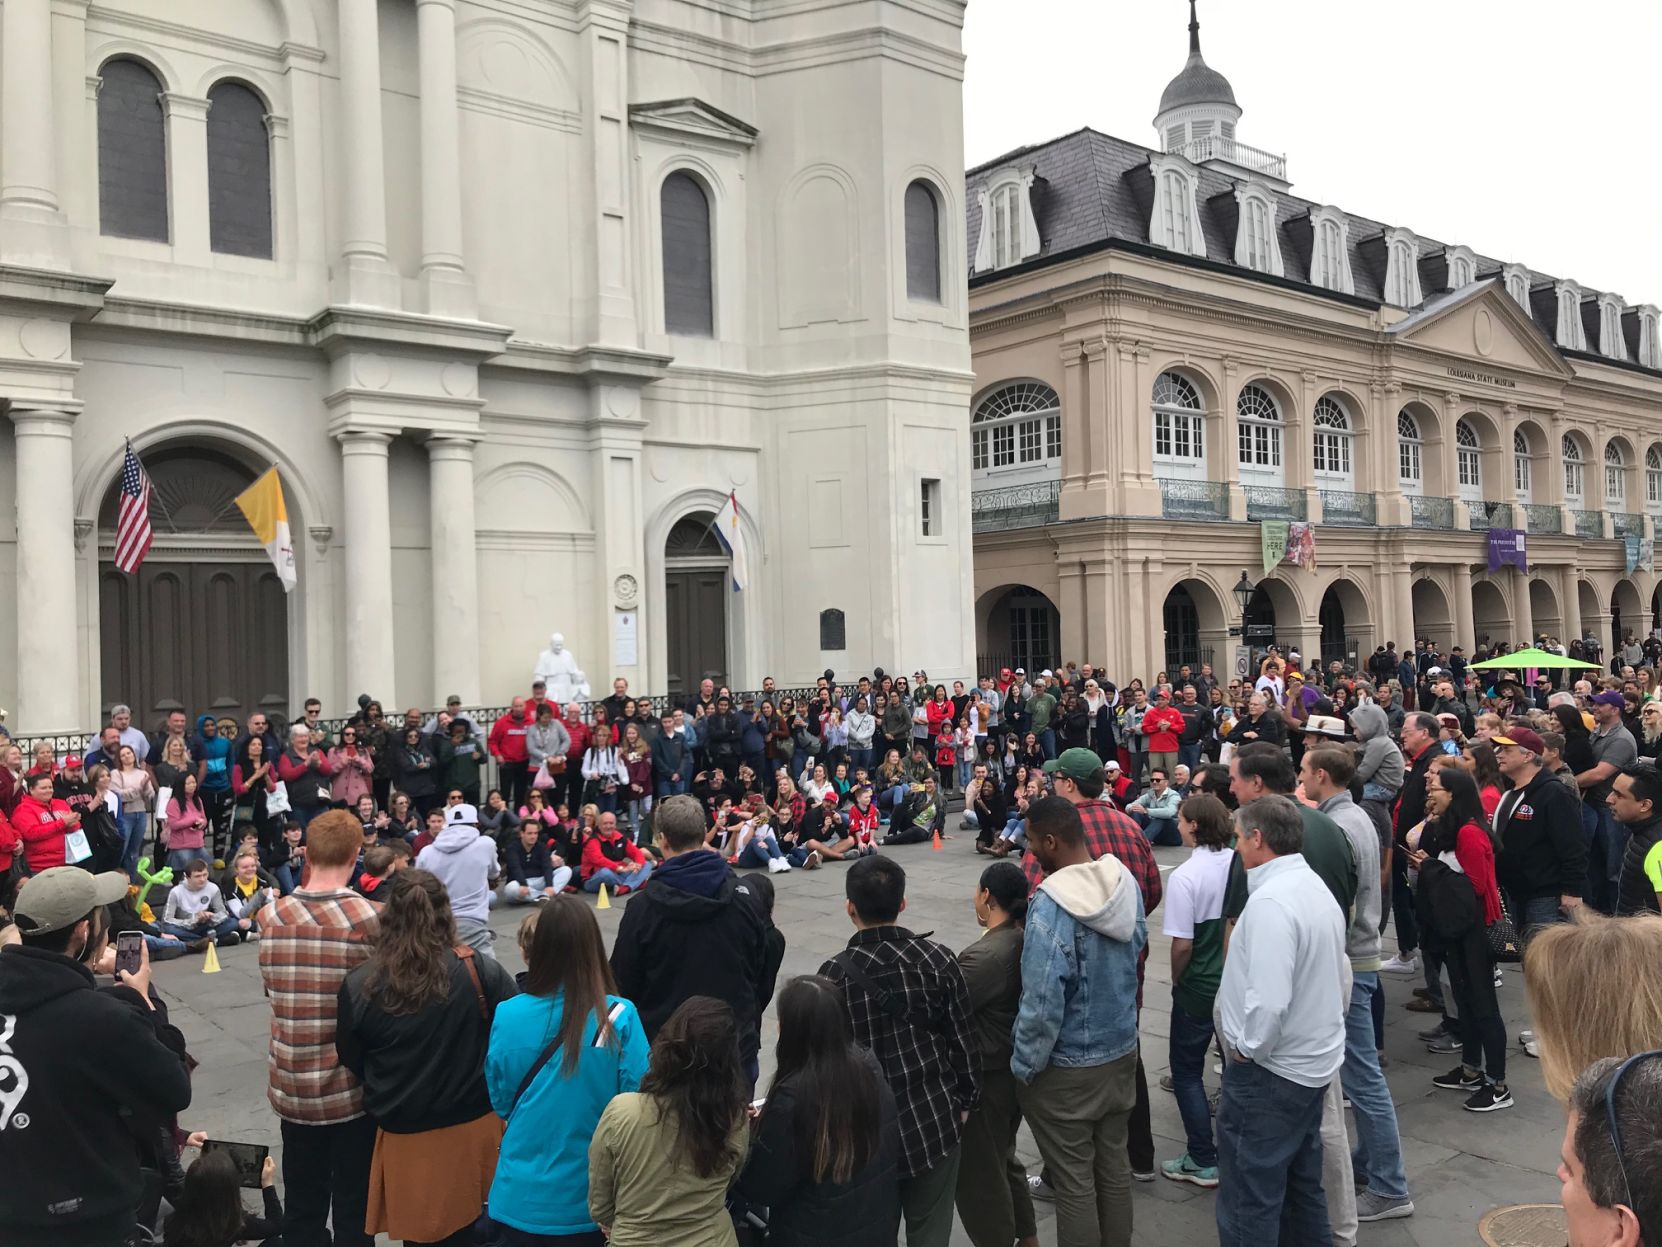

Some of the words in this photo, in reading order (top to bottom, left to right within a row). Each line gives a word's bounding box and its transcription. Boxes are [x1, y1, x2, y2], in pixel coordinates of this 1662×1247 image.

[1447, 367, 1476, 381] LOUISIANA
[1476, 374, 1493, 384] STATE
[1494, 378, 1516, 388] MUSEUM
[1266, 542, 1283, 550] HERE
